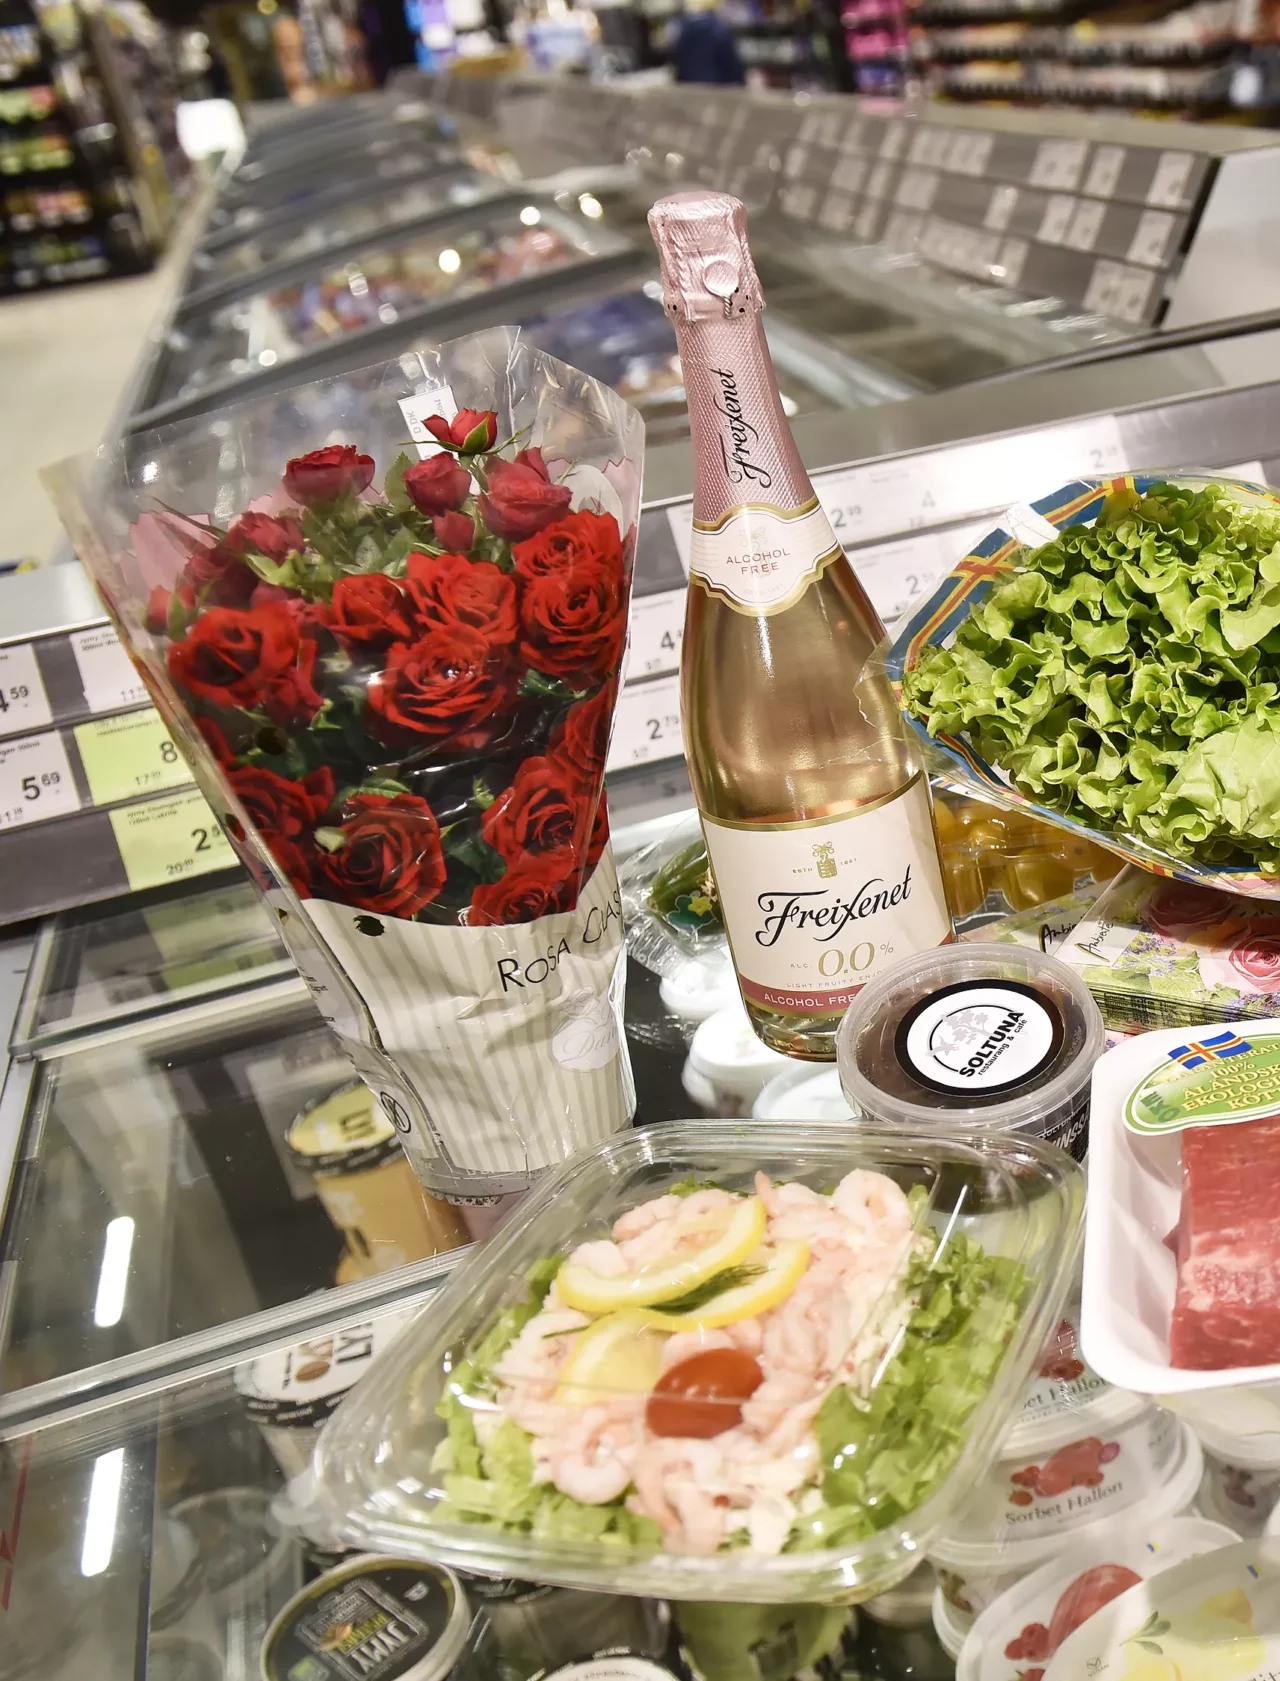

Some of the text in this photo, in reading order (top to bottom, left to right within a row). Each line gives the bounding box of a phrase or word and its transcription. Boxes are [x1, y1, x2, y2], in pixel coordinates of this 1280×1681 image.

[709, 368, 771, 489] Freixenet
[726, 548, 790, 564] ALCOHOL
[741, 561, 779, 575] FREE
[755, 864, 912, 947] Freixenet
[497, 938, 571, 992] ROSA
[764, 991, 823, 1007] ALCOHOL
[819, 978, 854, 988] FRUITY
[959, 1012, 1024, 1078] SOLTUNA
[978, 1043, 1009, 1075] restaurang
[1014, 1019, 1028, 1034] café
[1166, 1043, 1280, 1084] GARANTERAT
[1211, 1062, 1255, 1080] 100%
[1005, 1502, 1061, 1526] Sorbet
